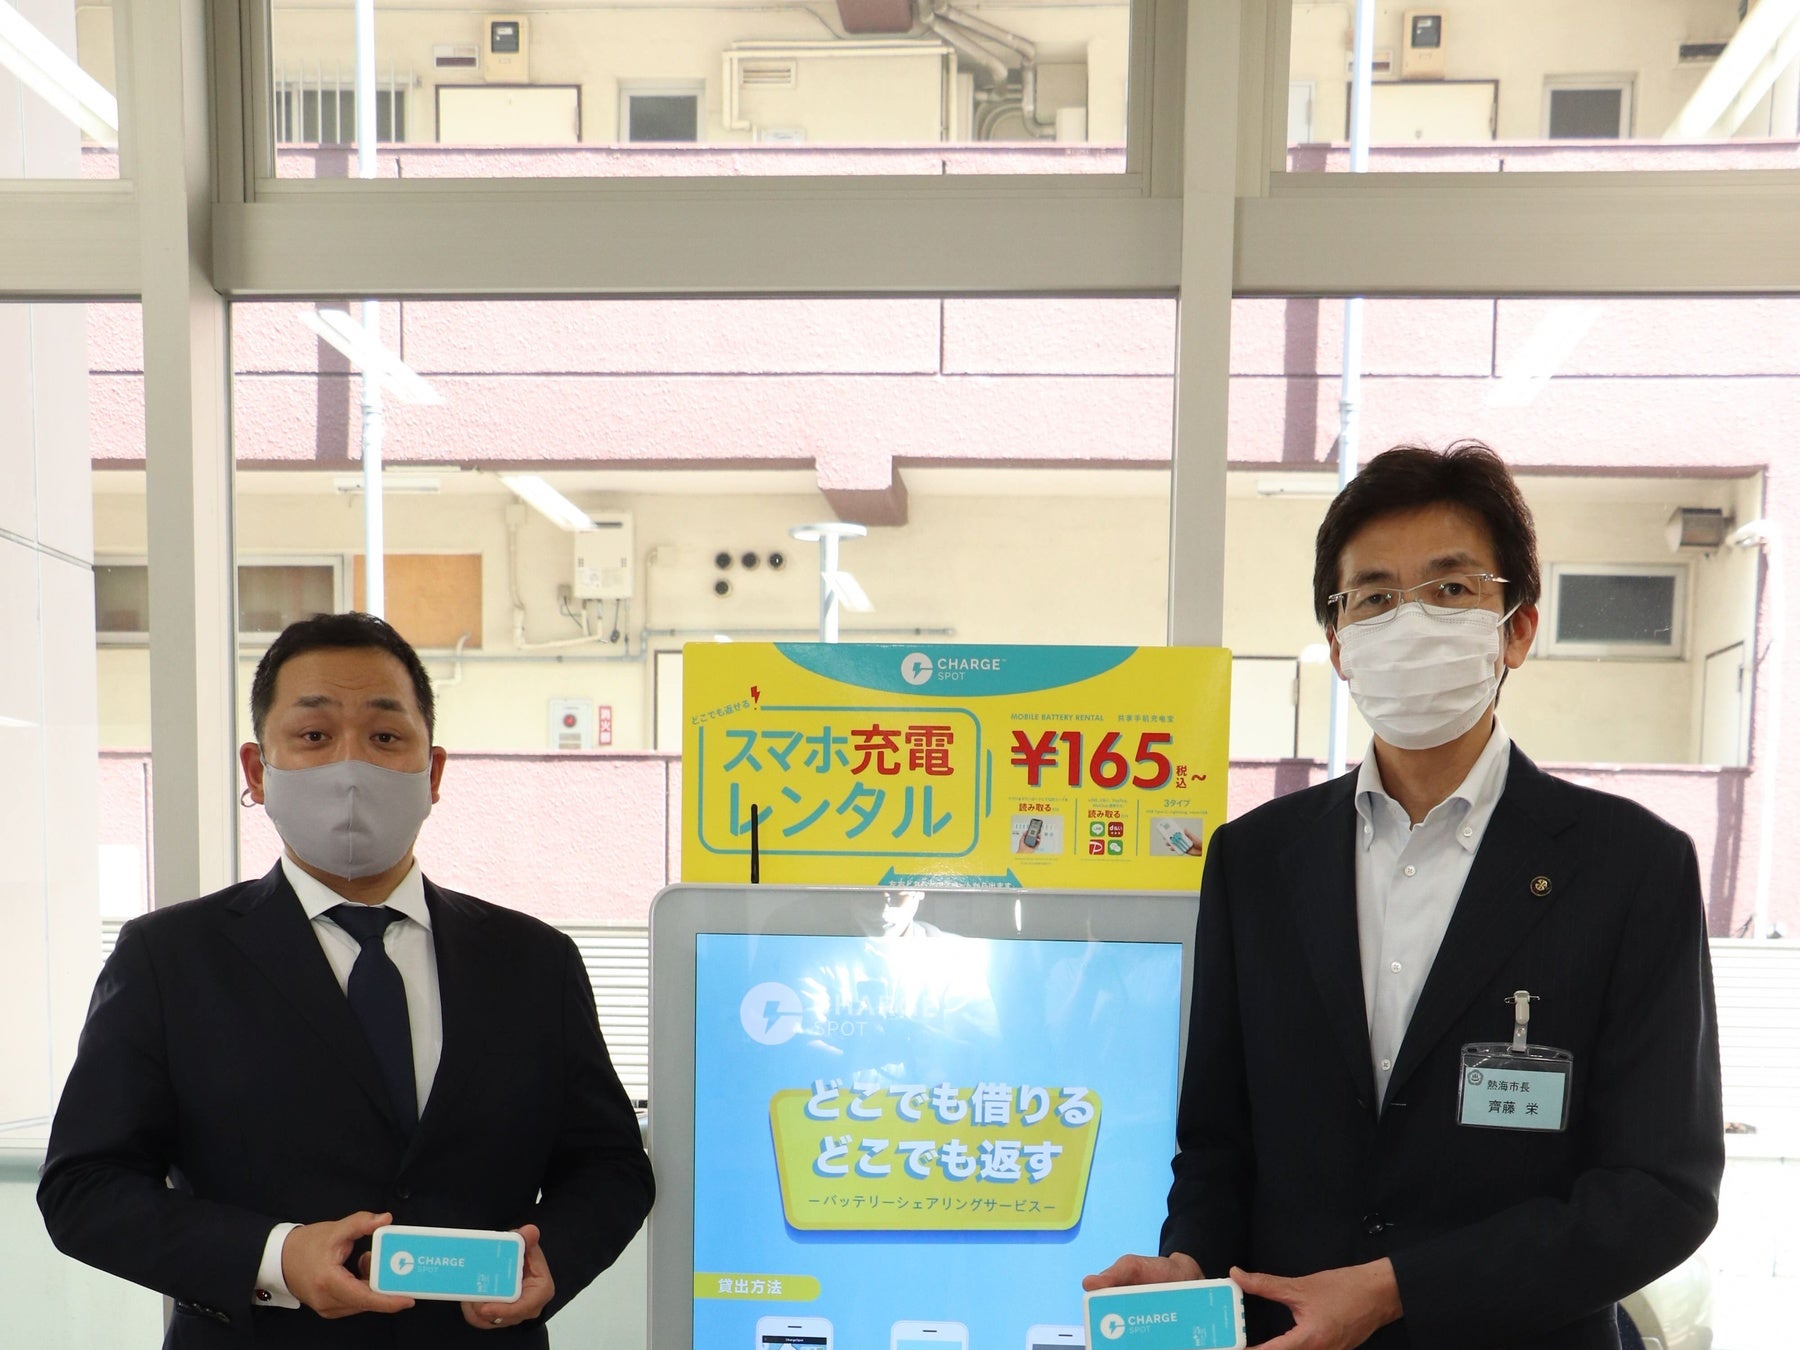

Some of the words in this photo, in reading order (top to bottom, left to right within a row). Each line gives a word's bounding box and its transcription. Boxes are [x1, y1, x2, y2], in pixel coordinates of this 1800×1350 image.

[937, 658, 1001, 671] CHARGE
[937, 671, 965, 681] SPOT
[1010, 713, 1039, 721] MOBILE
[1041, 713, 1073, 721] BATTERY
[1075, 714, 1104, 722] RENTAL
[723, 723, 955, 777] スマホ充電
[1010, 730, 1174, 790] ¥165
[1176, 765, 1188, 789] 税込
[729, 780, 952, 839] レンタル
[814, 1021, 868, 1037] SPOT
[1486, 1079, 1530, 1093] 熱海市長
[803, 1078, 1095, 1128] どこでも借りる
[1525, 1102, 1539, 1115] 栄
[812, 1134, 1063, 1185] どこでも返す
[417, 1255, 465, 1268] CHARGE
[717, 1277, 783, 1297] 貸出方法
[1127, 1312, 1178, 1326] CHARGE
